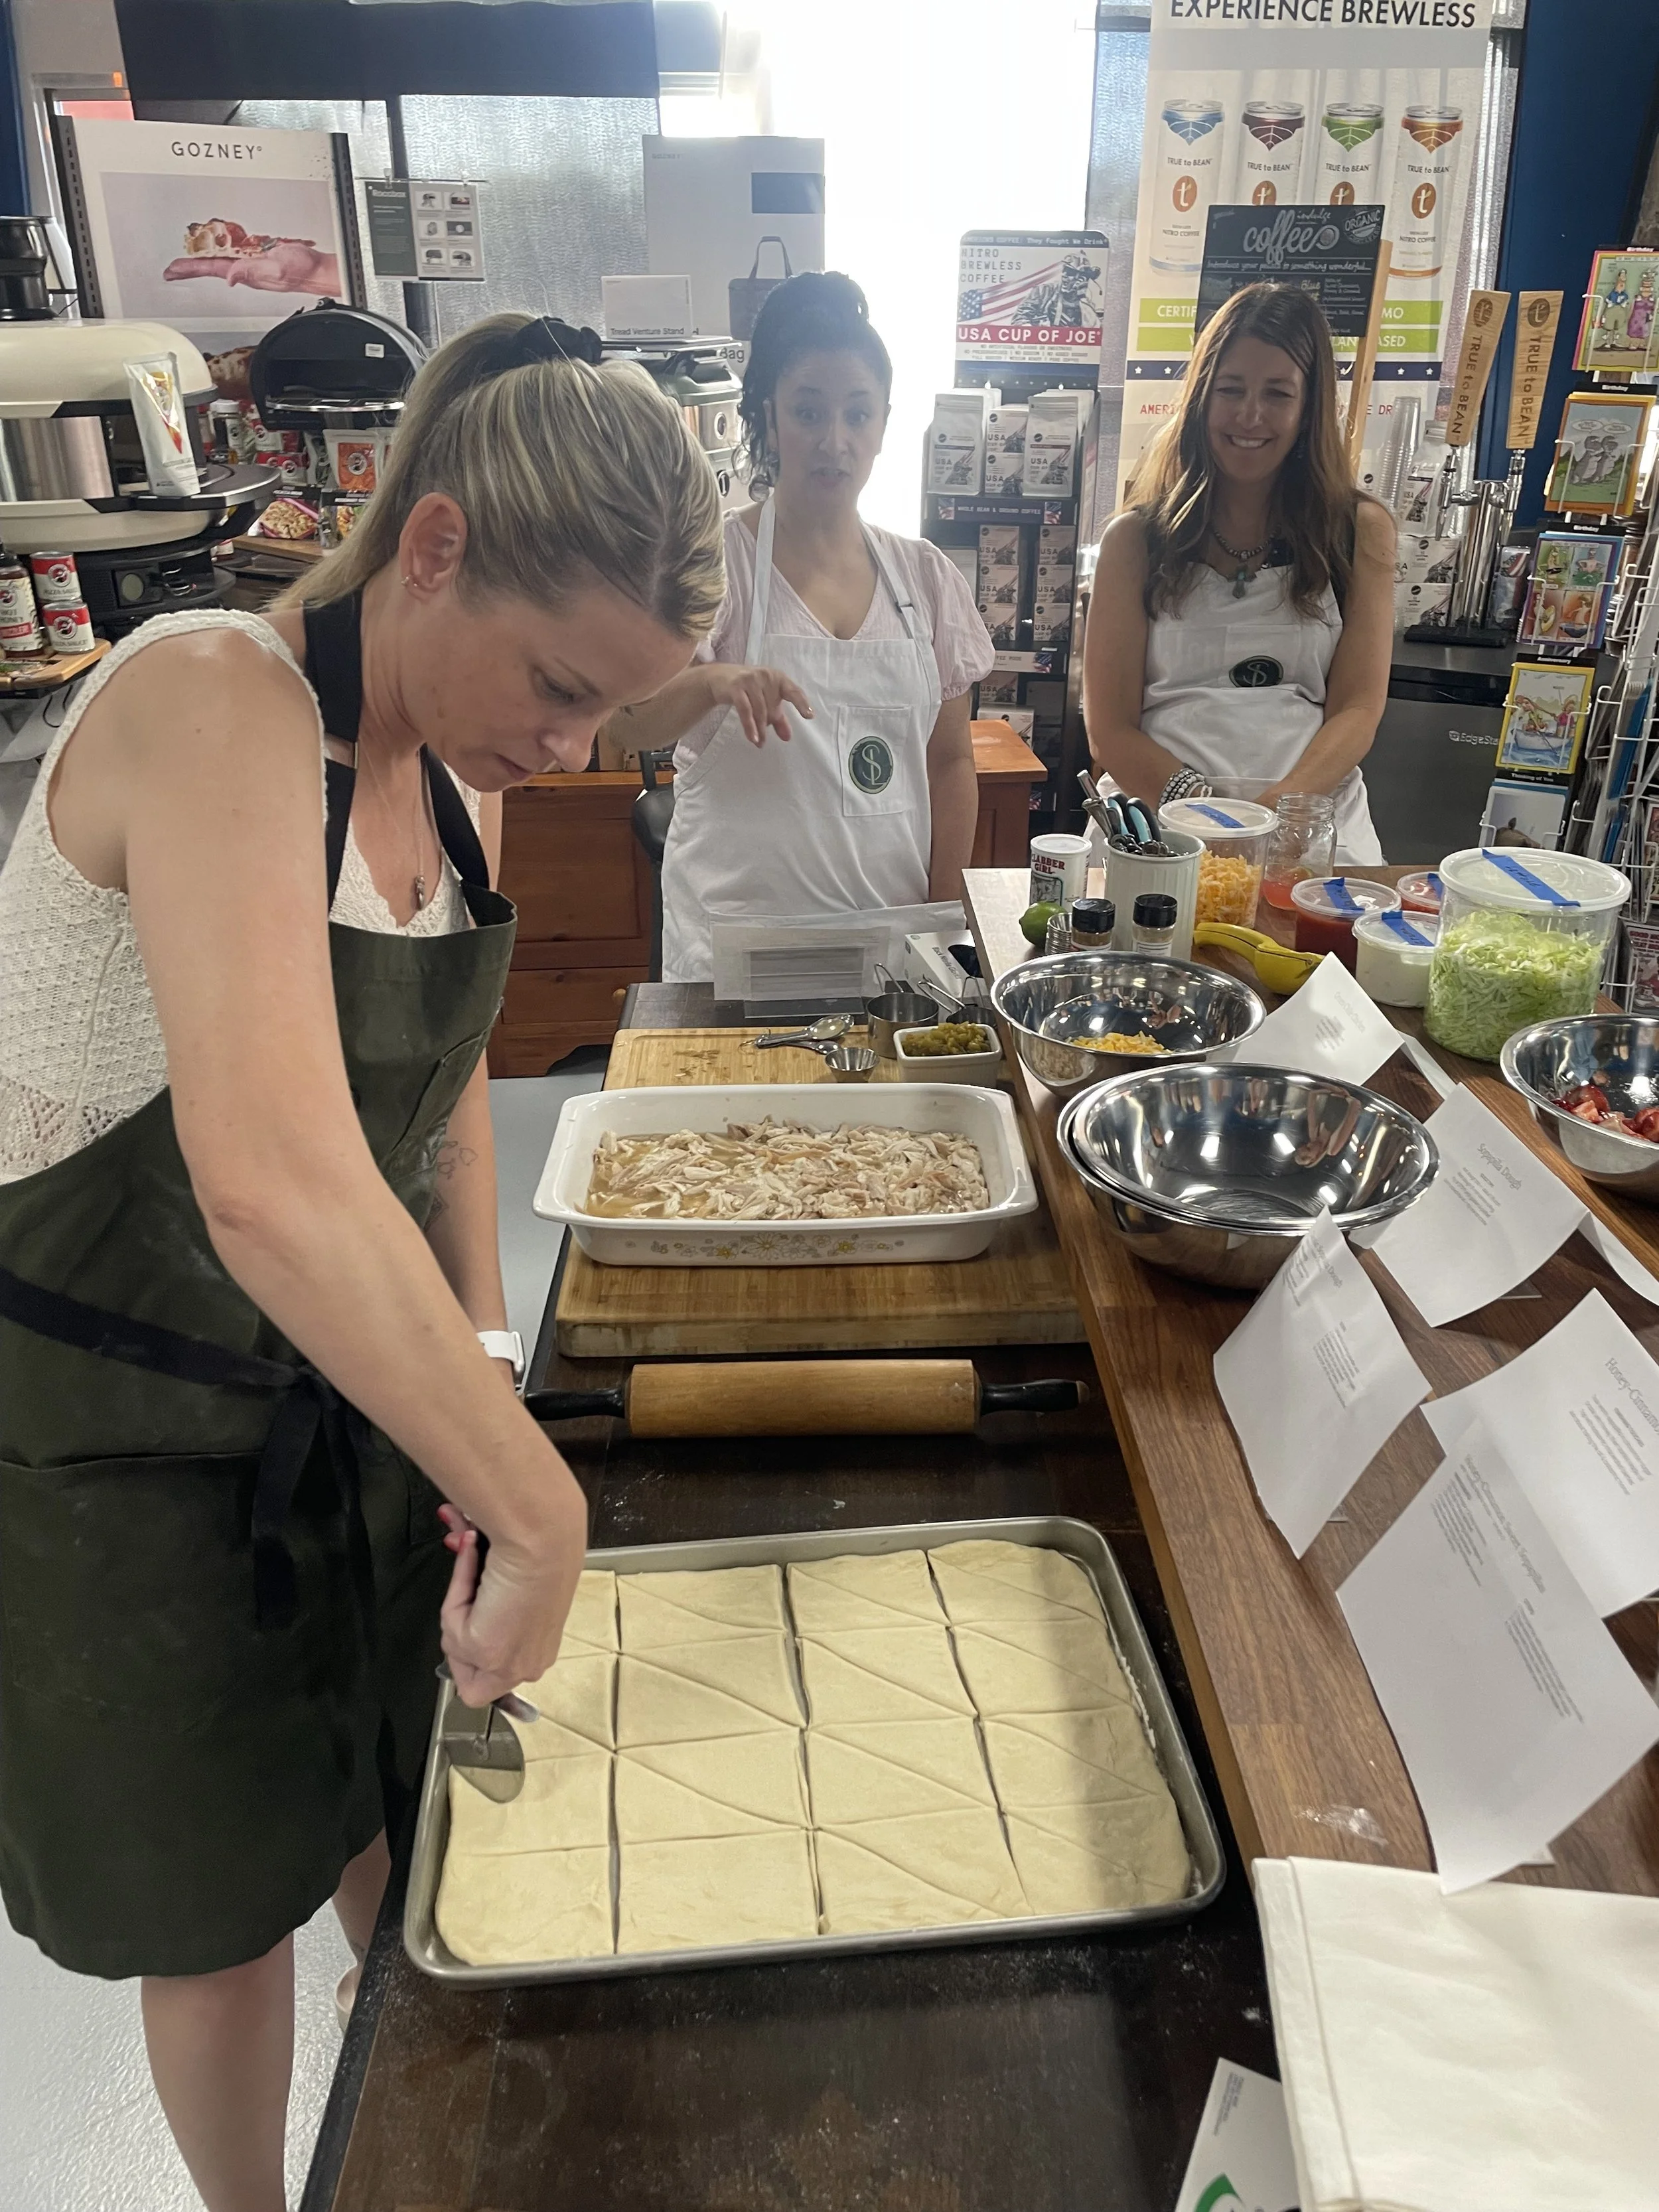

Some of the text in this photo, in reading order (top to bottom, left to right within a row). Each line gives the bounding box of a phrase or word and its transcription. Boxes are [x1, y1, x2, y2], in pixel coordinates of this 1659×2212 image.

[1171, 0, 1475, 28] EXPERIENCE BREWLESS
[171, 141, 255, 160] GOZNEY
[1167, 157, 1182, 166] TRUE
[1248, 162, 1262, 171] TRUE
[1326, 163, 1341, 172] TRUE
[1407, 165, 1423, 173] TRUE
[1344, 209, 1381, 232] ORGANIC
[1243, 210, 1331, 264] coffee
[961, 248, 999, 258] NITRO
[960, 261, 1022, 271] BREWLESS
[960, 273, 1005, 283] COFFEE
[1157, 305, 1197, 317] CERTIF
[1382, 307, 1404, 319] MO
[958, 328, 1096, 344] USA CUP OF JOE
[1378, 335, 1406, 347] ASED
[720, 346, 745, 363] Bag
[1465, 335, 1483, 372] TRUE
[1461, 374, 1475, 390] to
[1517, 335, 1542, 437] TRUE to BEAN
[1140, 404, 1175, 414] AMERI
[1452, 394, 1470, 434] BEAN
[1461, 733, 1498, 746] EdgeSta
[1035, 863, 1056, 874] GIRL
[1500, 1166, 1523, 1190] Dough
[1605, 1357, 1659, 1434] Honey-Cinnamo
